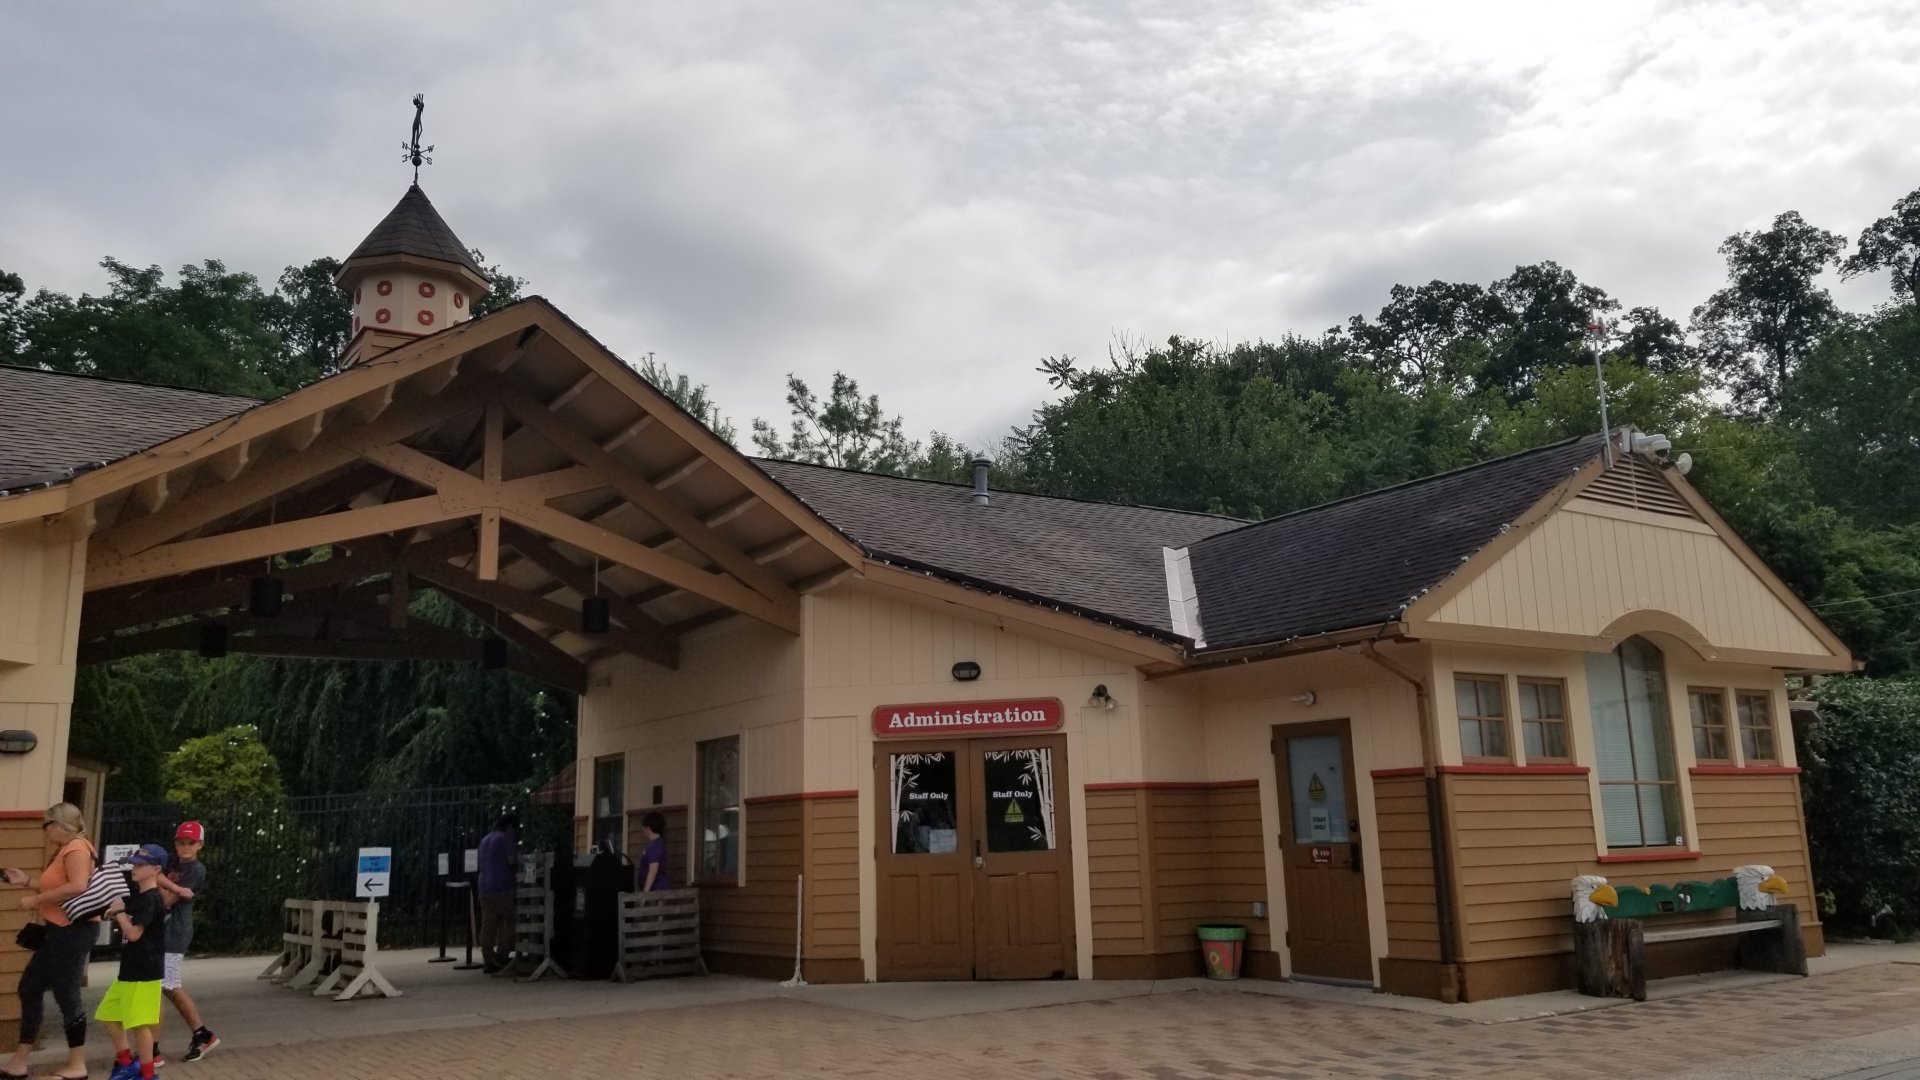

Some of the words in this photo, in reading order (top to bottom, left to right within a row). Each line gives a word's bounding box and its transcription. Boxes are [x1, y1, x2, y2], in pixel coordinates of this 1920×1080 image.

[888, 707, 1046, 728] Administration
[909, 792, 929, 800] Staff
[930, 792, 949, 800] Only
[1014, 790, 1033, 799] Only
